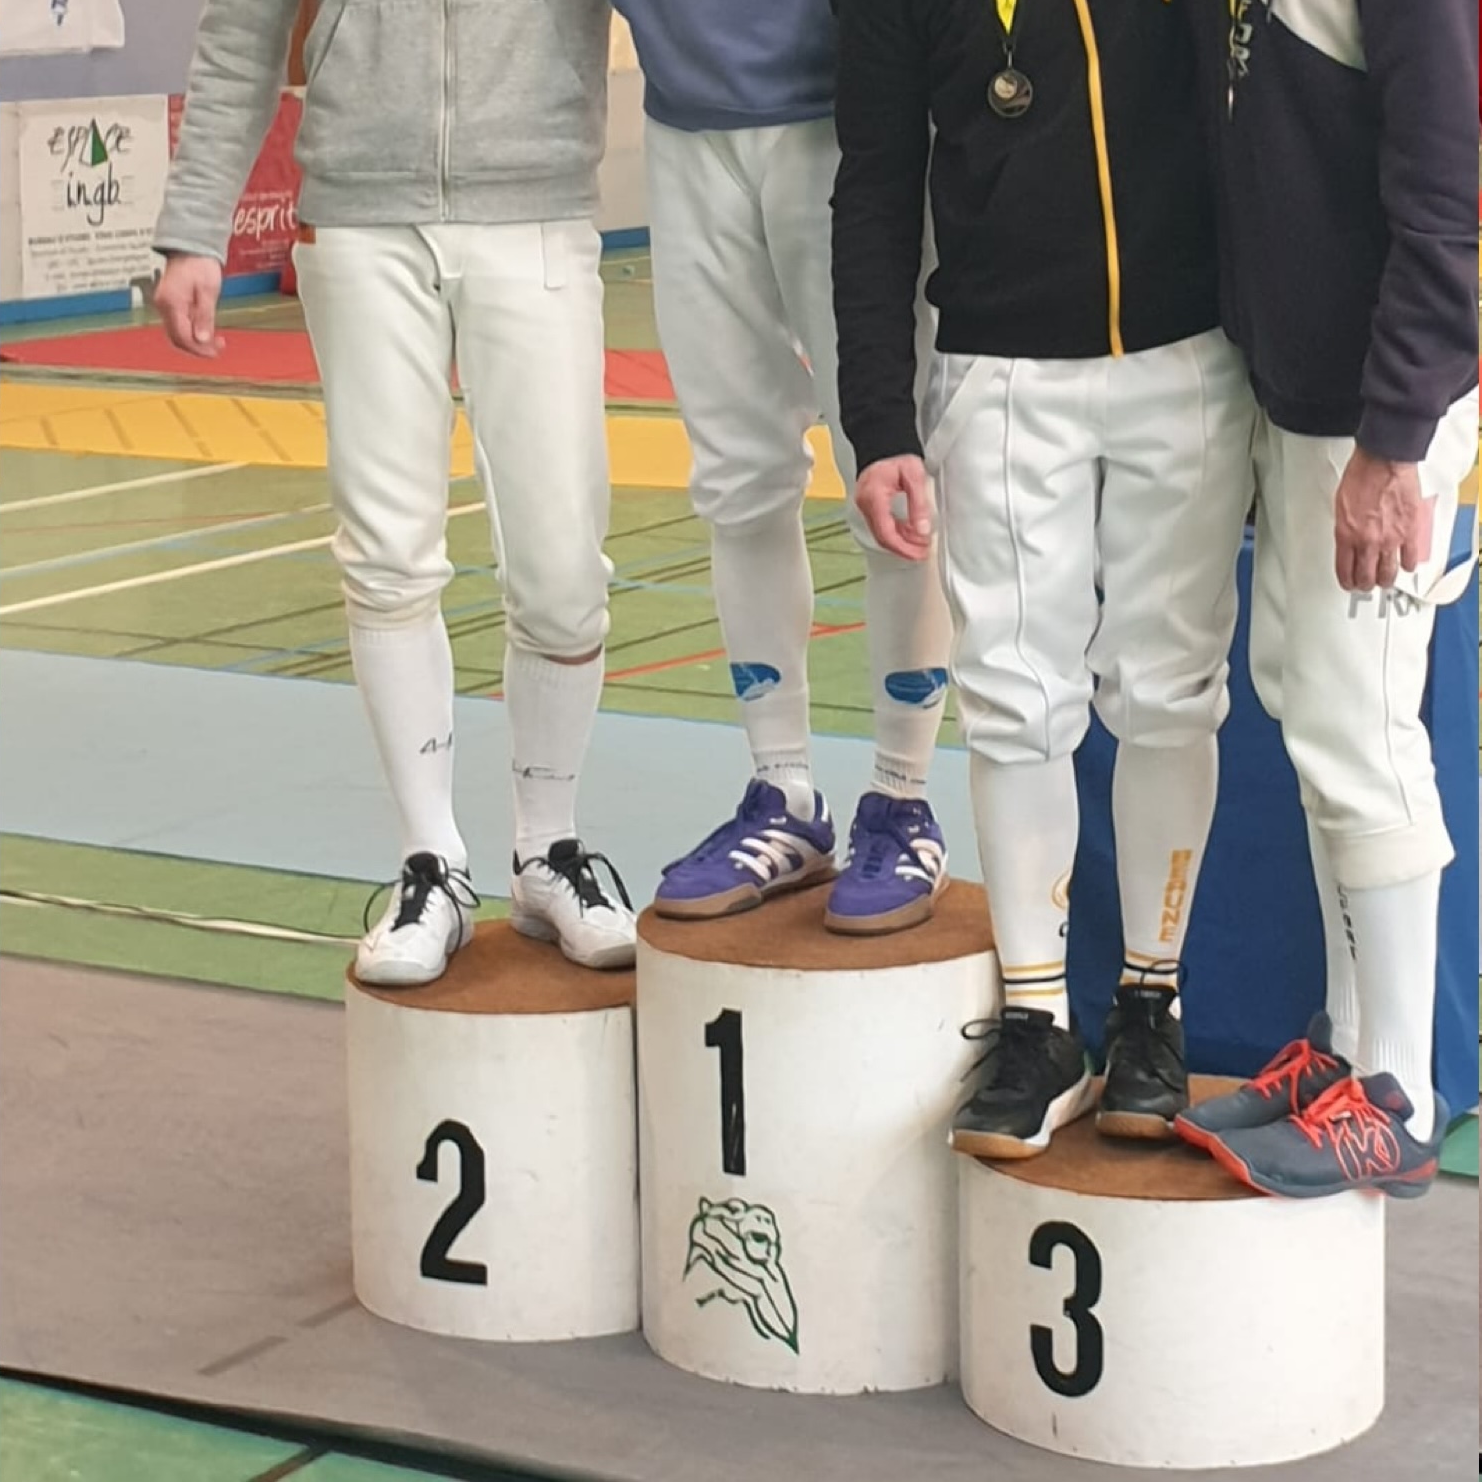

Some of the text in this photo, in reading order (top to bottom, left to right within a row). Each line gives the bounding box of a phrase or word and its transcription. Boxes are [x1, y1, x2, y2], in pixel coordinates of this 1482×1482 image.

[233, 197, 297, 242] esprit
[704, 1008, 747, 1177] 1
[415, 1119, 488, 1287] 2
[1028, 1220, 1104, 1399] 3
